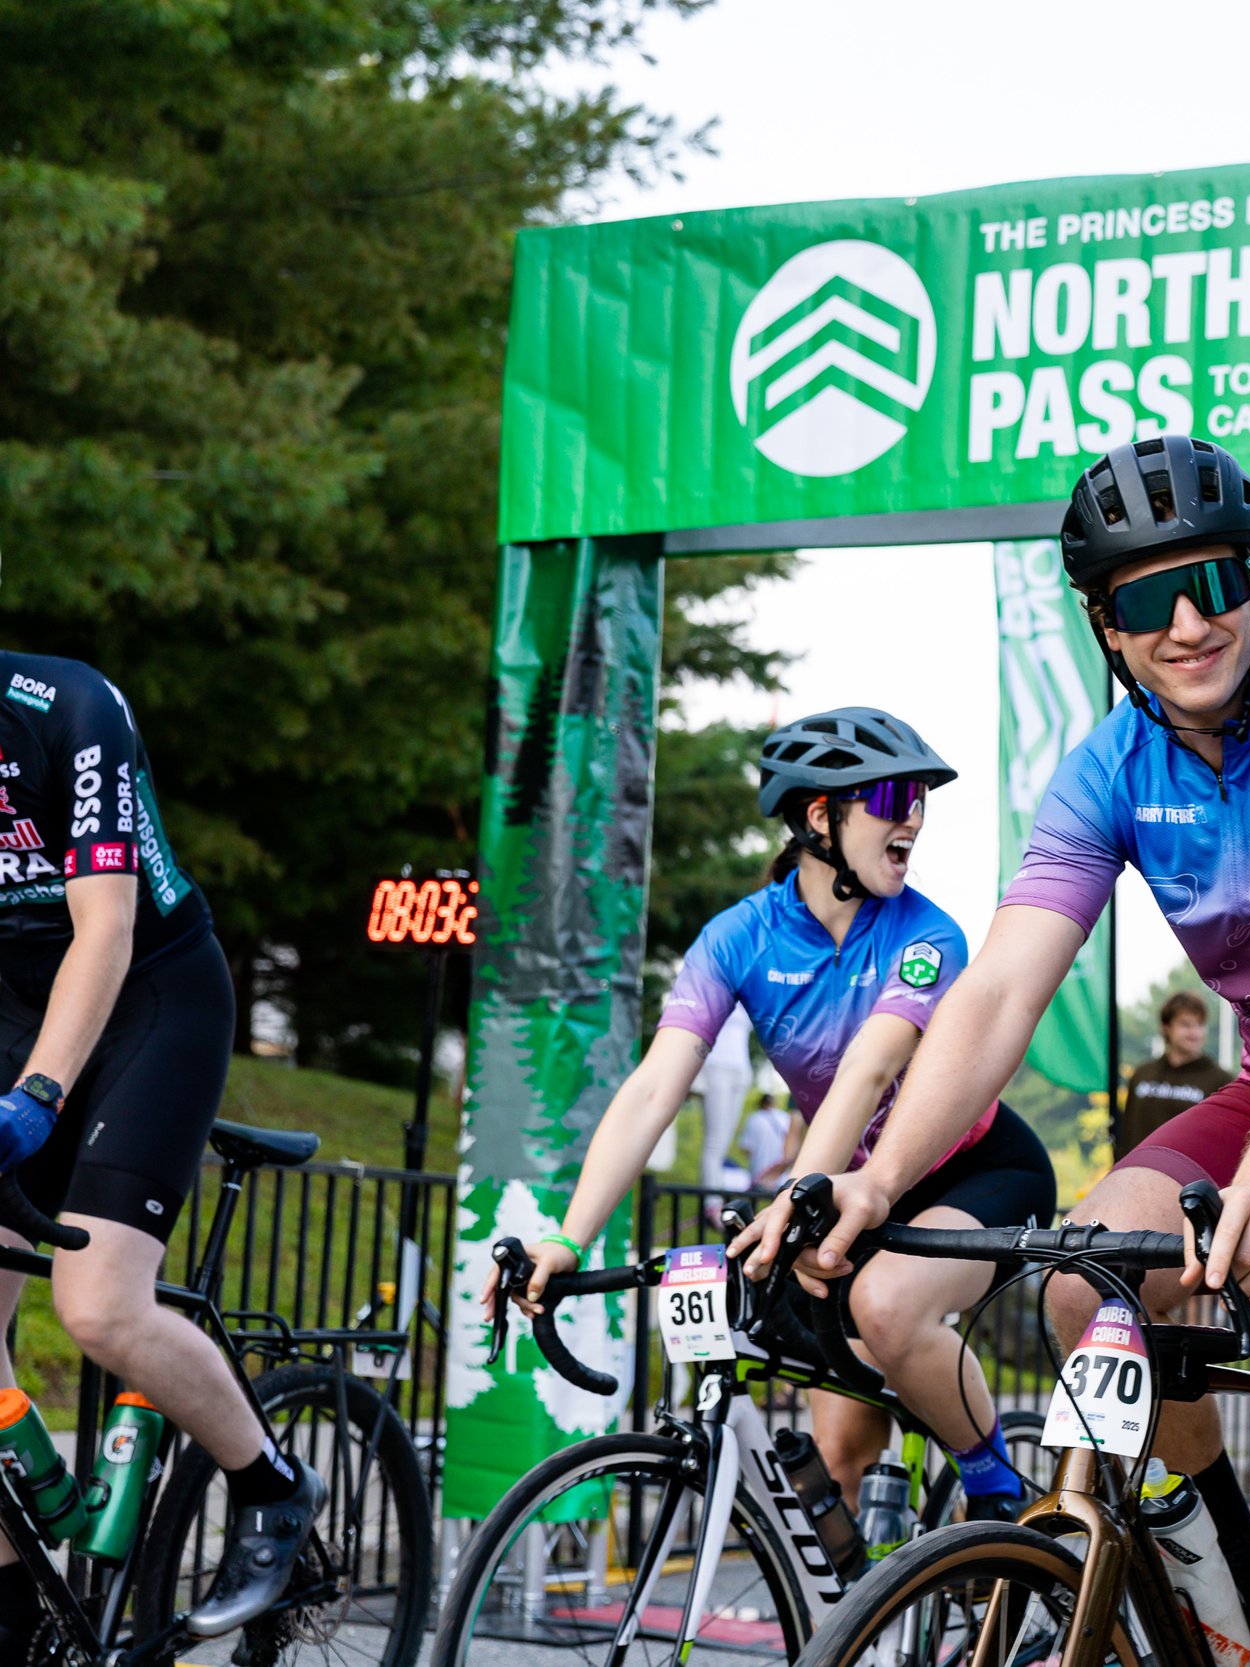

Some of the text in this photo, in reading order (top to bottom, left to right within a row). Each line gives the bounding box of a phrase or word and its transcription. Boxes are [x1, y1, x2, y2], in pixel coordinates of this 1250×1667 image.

[980, 217, 1046, 253] THE
[1057, 197, 1234, 245] PRINCESS
[968, 355, 1194, 462] PASS
[10, 673, 56, 701] BORA
[71, 744, 102, 838] BOSS
[117, 761, 133, 833] BORA
[136, 777, 176, 905] nsgrohe
[0, 852, 61, 885] RA
[96, 858, 122, 867] TAL
[670, 1290, 714, 1325] 361
[1095, 1306, 1133, 1326] RUBEN
[1091, 1326, 1131, 1346] COHEN
[1066, 1354, 1142, 1405] 370
[103, 1425, 138, 1465] G
[1121, 1420, 1140, 1431] 2025
[750, 1449, 845, 1604] SCO
